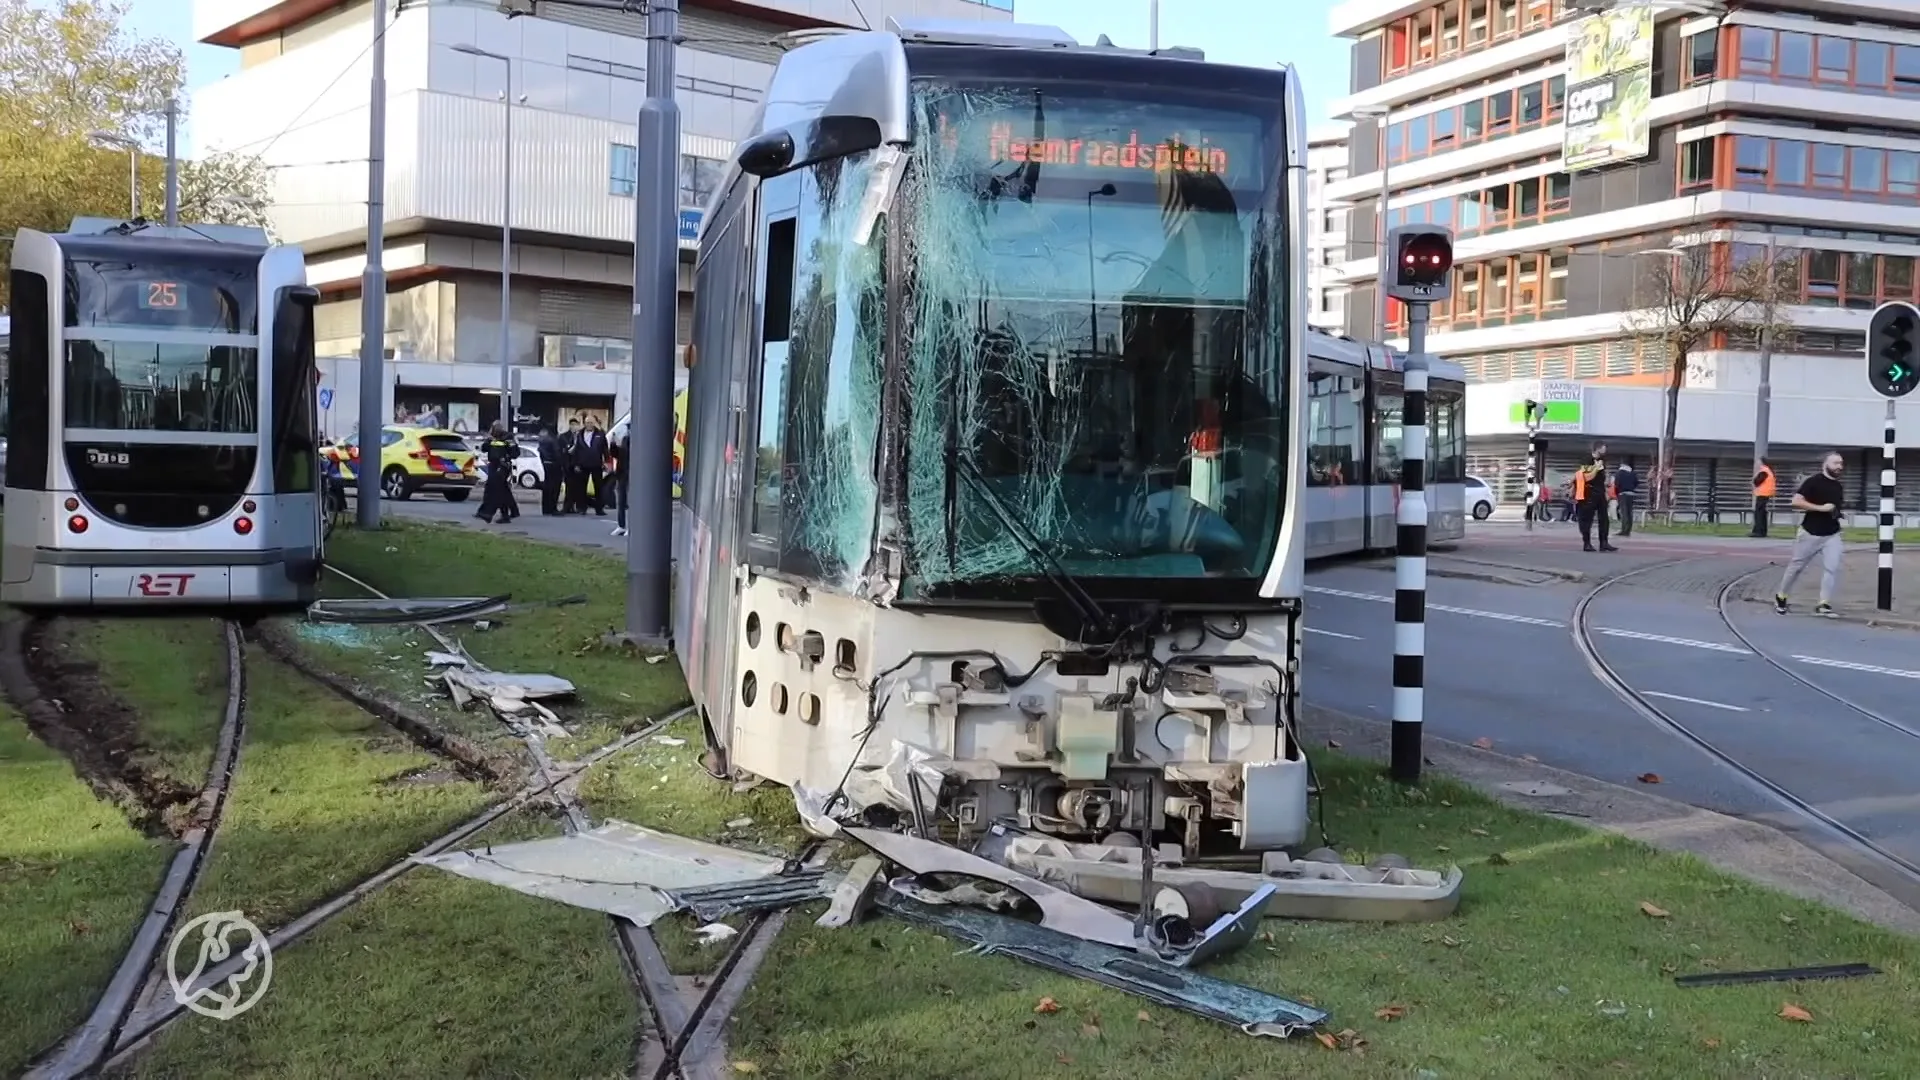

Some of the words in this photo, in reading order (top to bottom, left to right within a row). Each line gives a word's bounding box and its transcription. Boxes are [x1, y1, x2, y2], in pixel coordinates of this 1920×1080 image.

[148, 282, 177, 306] 25
[1543, 391, 1581, 400] LYCEUM
[137, 573, 196, 596] RET
